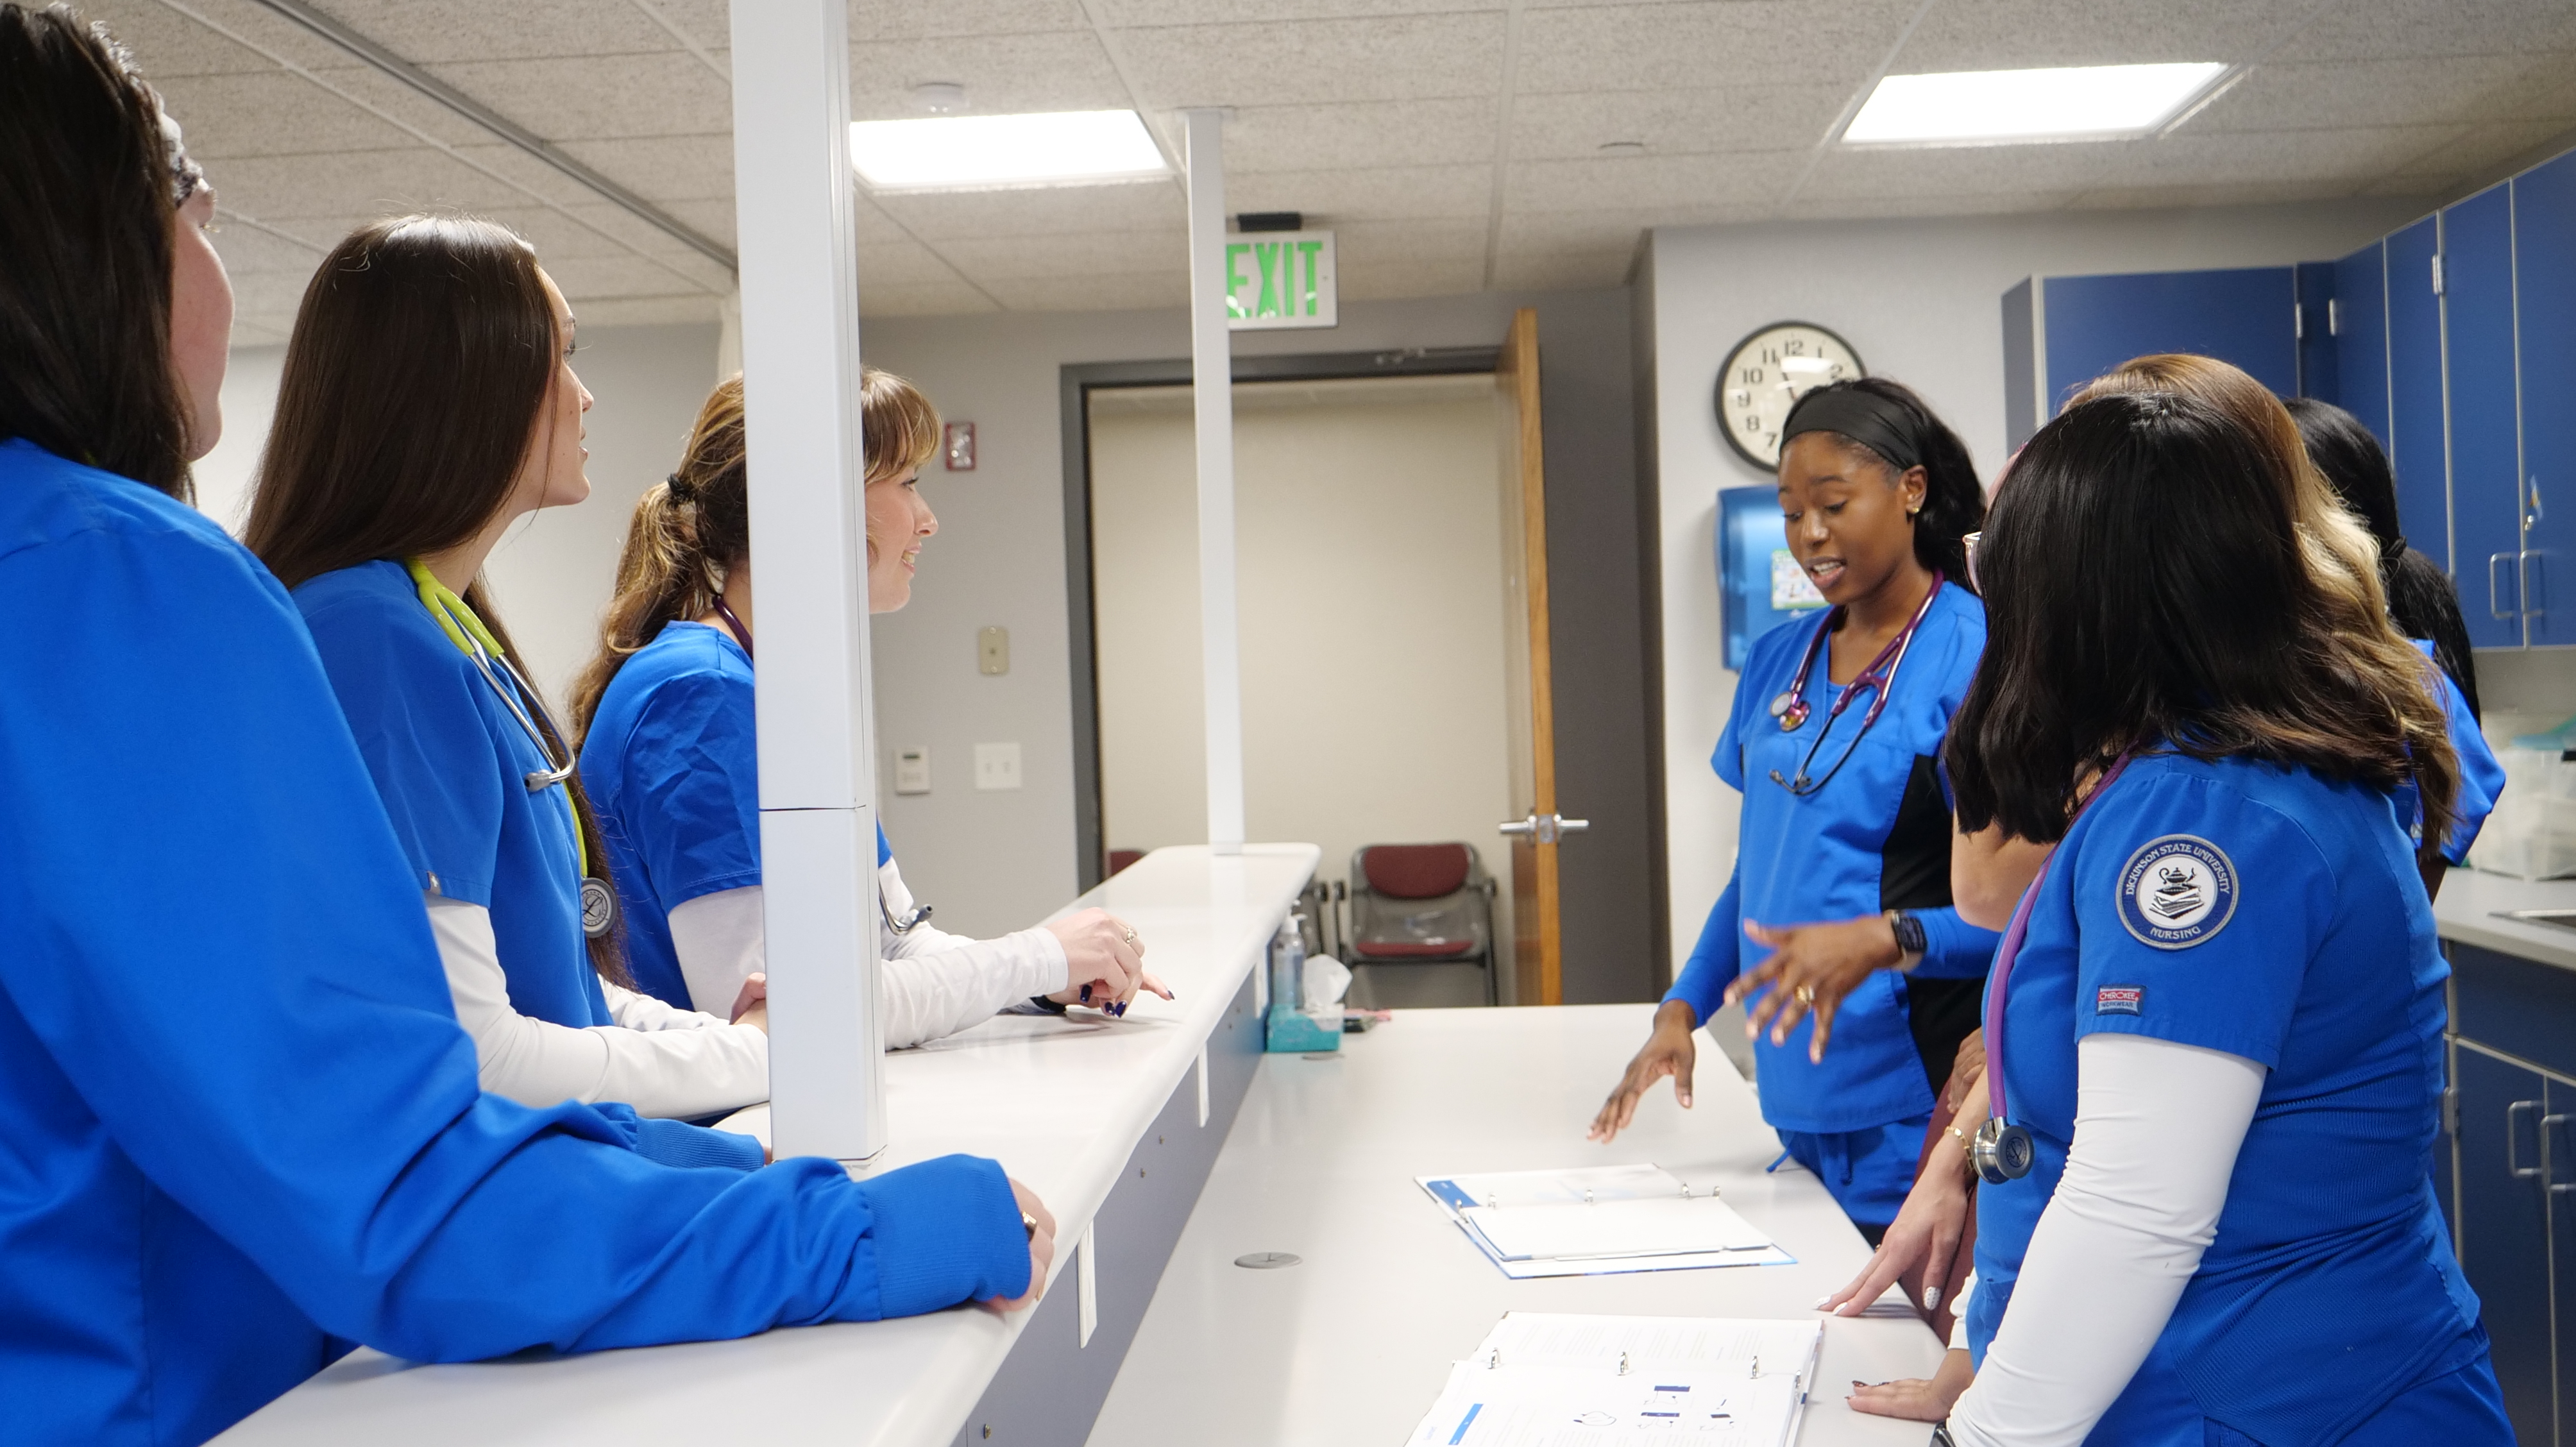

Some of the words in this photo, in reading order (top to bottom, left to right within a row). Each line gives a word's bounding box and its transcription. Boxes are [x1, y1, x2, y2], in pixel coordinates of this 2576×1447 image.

[1226, 241, 1323, 319] EXIT
[1784, 340, 1804, 356] 12
[1817, 346, 1823, 359] 1
[1762, 348, 1777, 365] 11
[1742, 368, 1763, 385] 10
[1829, 364, 1843, 380] 2
[1738, 391, 1750, 407] 9
[1747, 416, 1760, 432] 8
[1765, 433, 1777, 448] 7
[2125, 849, 2160, 895] DICKINSON
[2159, 843, 2192, 855] STATE
[2193, 846, 2230, 894] UNIVERSITY
[2149, 926, 2201, 940] NURSING
[2099, 992, 2135, 1000] CHEROKEE
